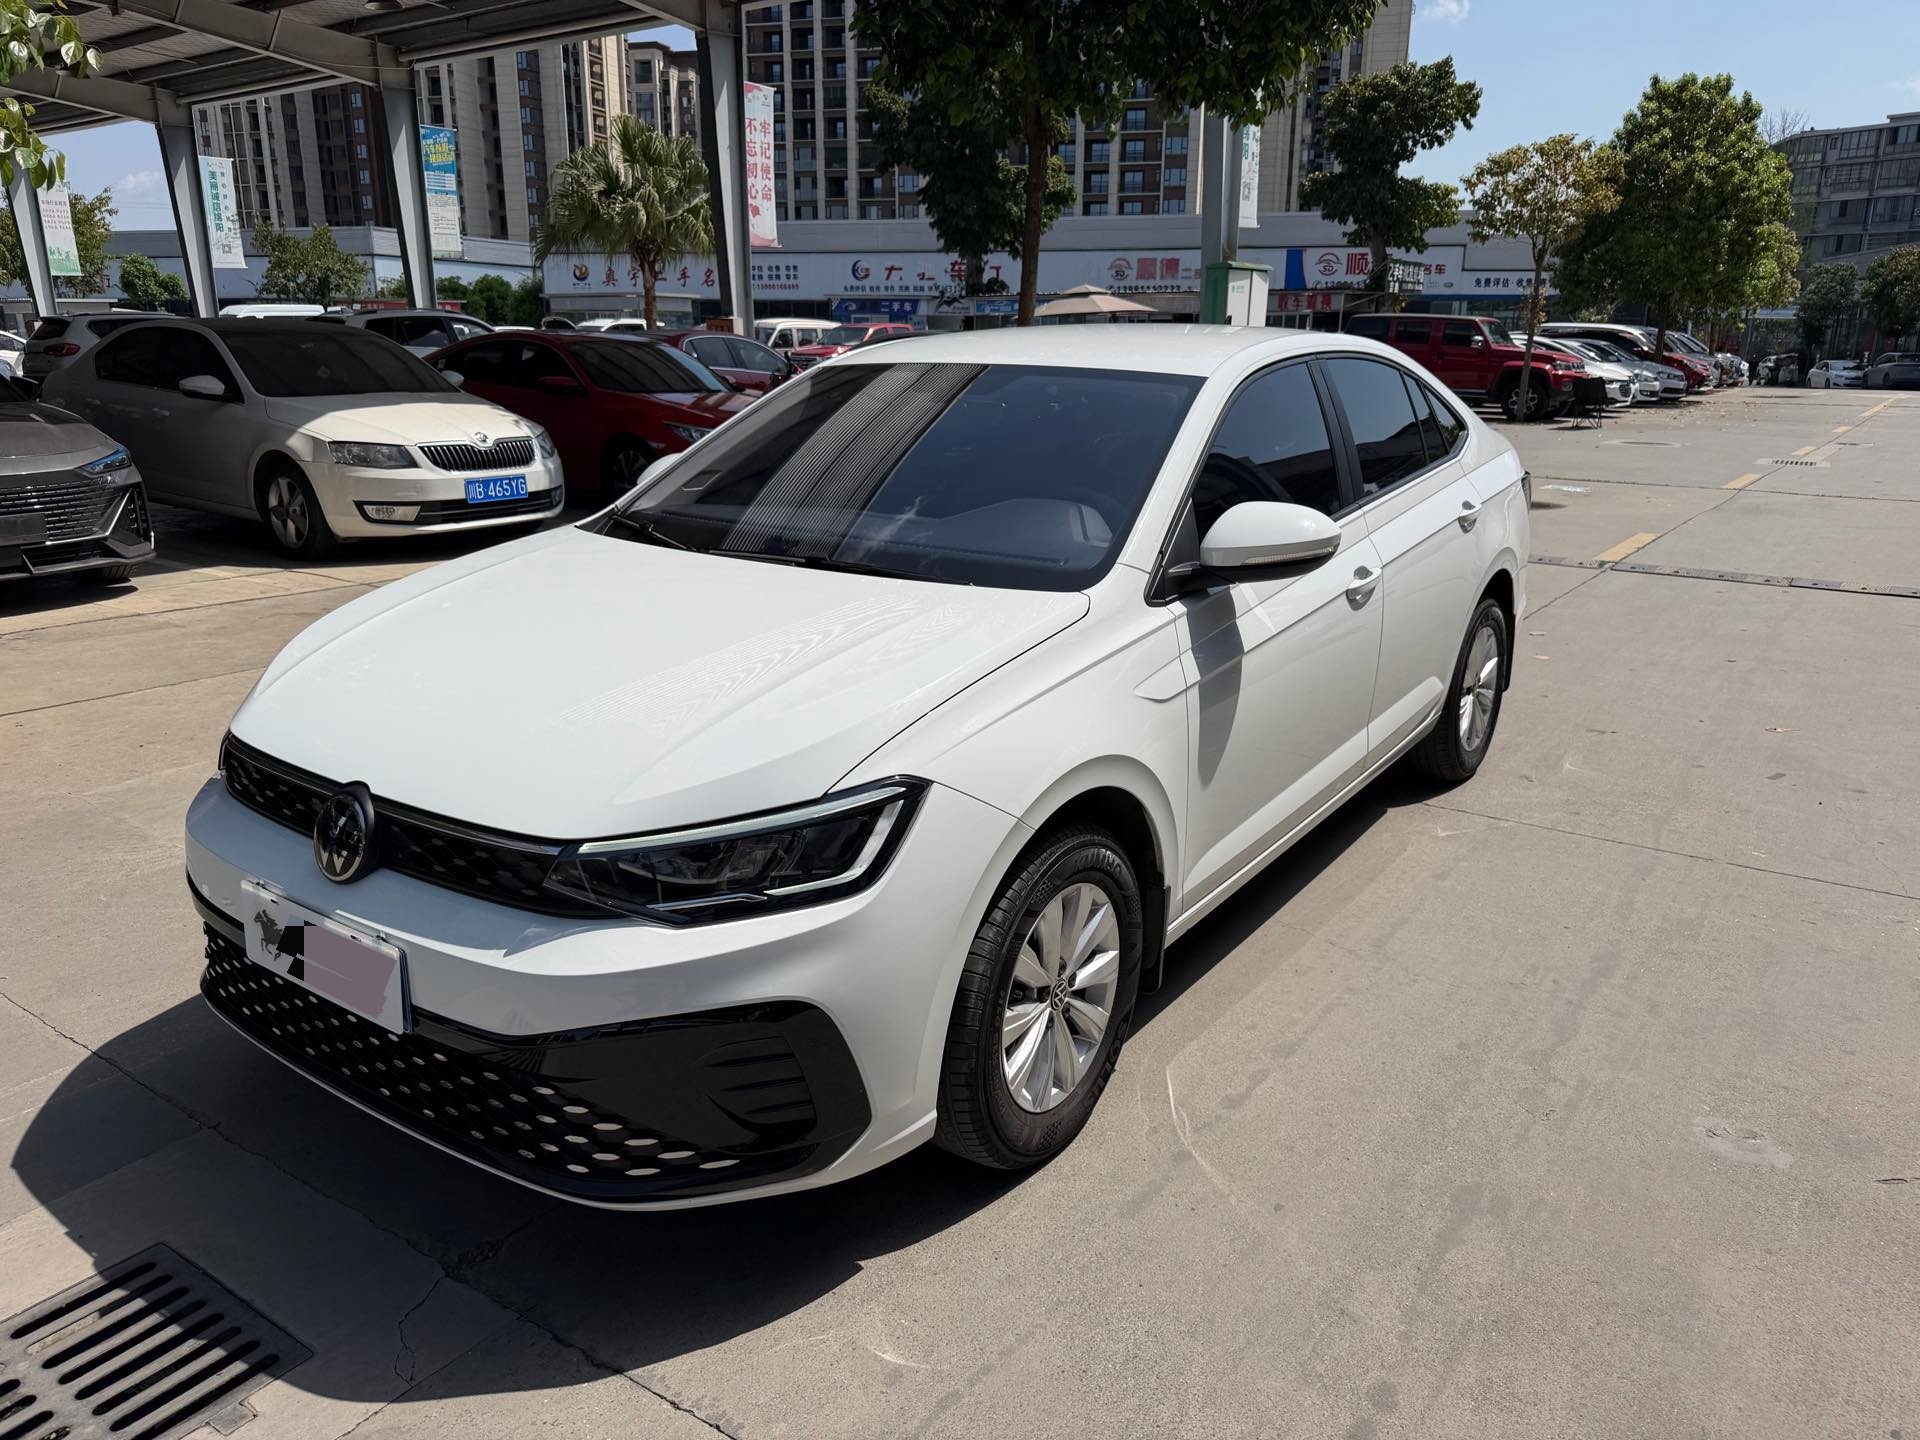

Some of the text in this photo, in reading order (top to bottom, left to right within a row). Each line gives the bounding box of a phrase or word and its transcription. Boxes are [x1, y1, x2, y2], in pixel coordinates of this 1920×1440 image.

[745, 117, 759, 200] 不忘初心
[759, 118, 773, 202] 牢记使命
